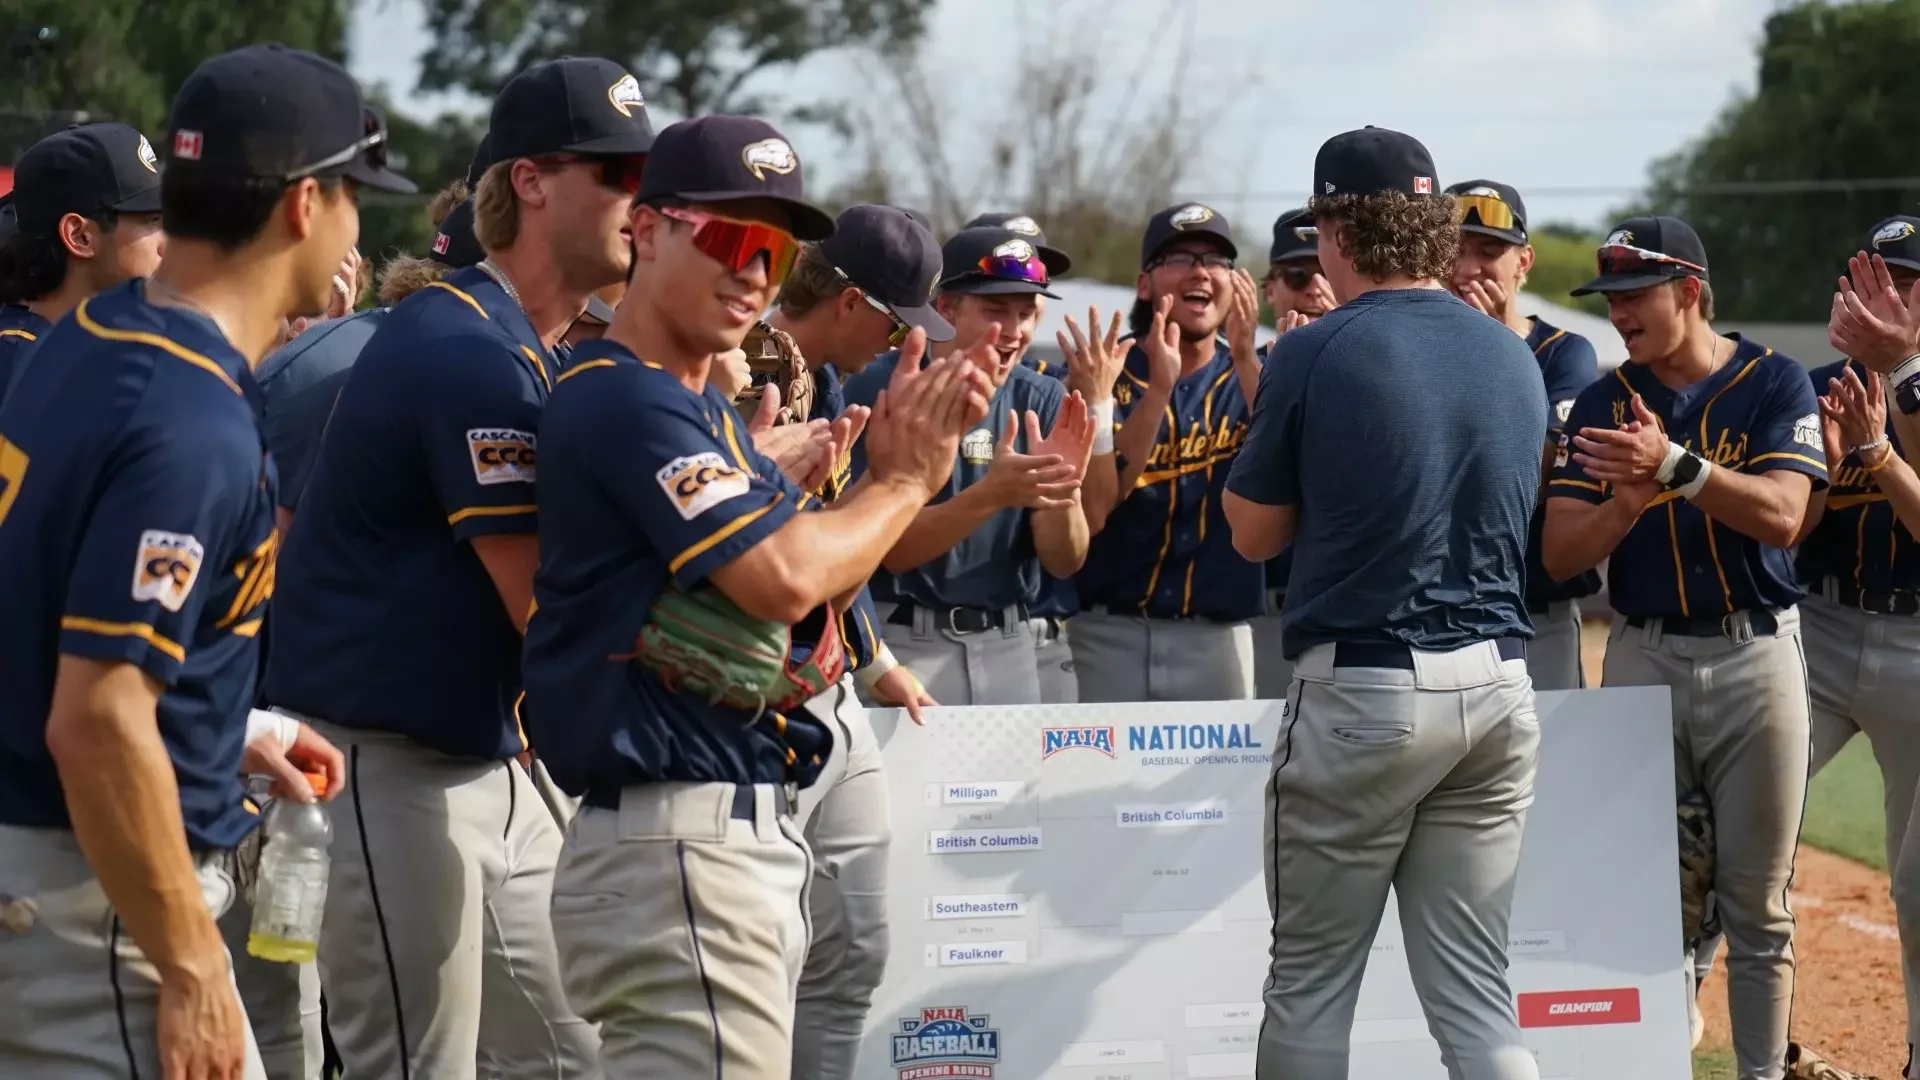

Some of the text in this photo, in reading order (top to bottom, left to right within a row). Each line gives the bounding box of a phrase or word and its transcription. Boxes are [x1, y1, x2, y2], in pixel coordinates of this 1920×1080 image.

[1044, 728, 1113, 756] NAIA
[1128, 723, 1262, 751] NATIONAL
[1141, 754, 1273, 767] BASEBALL OPENING ROUN
[949, 787, 998, 800] Milligan
[1121, 808, 1224, 824] British Columbia
[936, 836, 977, 848] British
[979, 834, 1039, 847] Columbia
[936, 901, 1018, 914] Southeastern
[949, 949, 1004, 960] Faulkner
[1549, 1001, 1613, 1014] CHAMPION
[923, 1008, 967, 1024] NAIA
[894, 1032, 997, 1061] BASEBALL
[901, 1064, 991, 1080] OPENING ROUND
